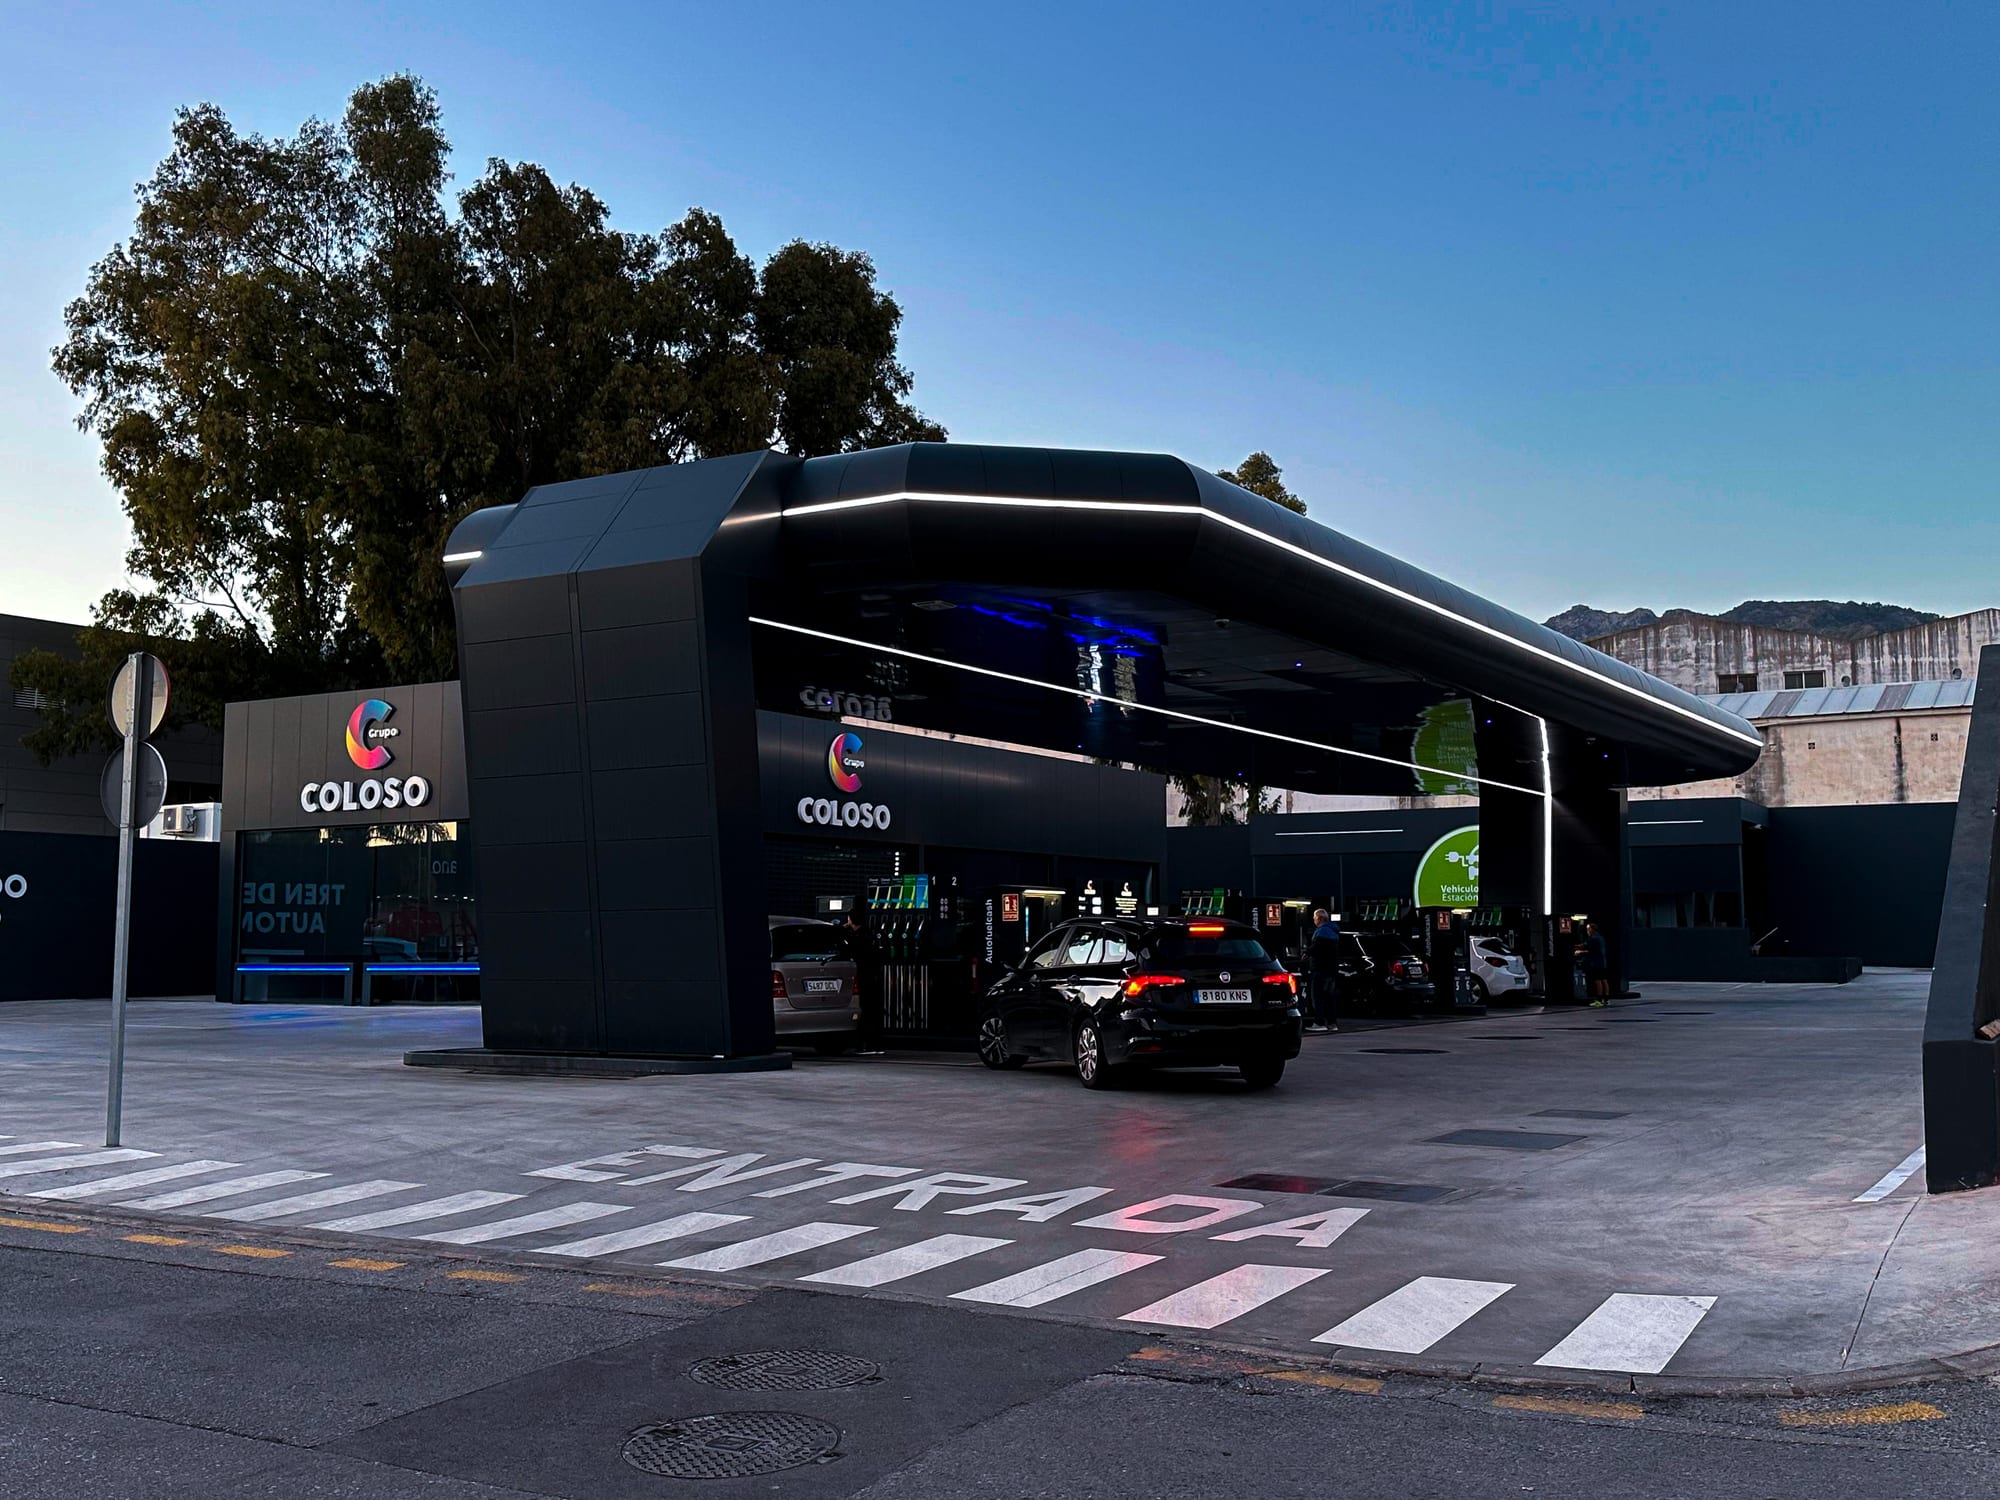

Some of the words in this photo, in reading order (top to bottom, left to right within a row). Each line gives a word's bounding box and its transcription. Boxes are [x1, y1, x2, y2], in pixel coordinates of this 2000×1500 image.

[368, 728, 398, 739] Grupo
[843, 757, 865, 769] Grupo
[300, 776, 429, 813] COLOSO
[797, 796, 891, 831] COLOSO
[0, 873, 27, 898] O
[951, 876, 957, 886] 2
[985, 898, 993, 964] Autofuelcash
[1202, 991, 1227, 1001] 8180
[1230, 991, 1248, 1001] KNS
[520, 1144, 1372, 1248] ENTRADA
